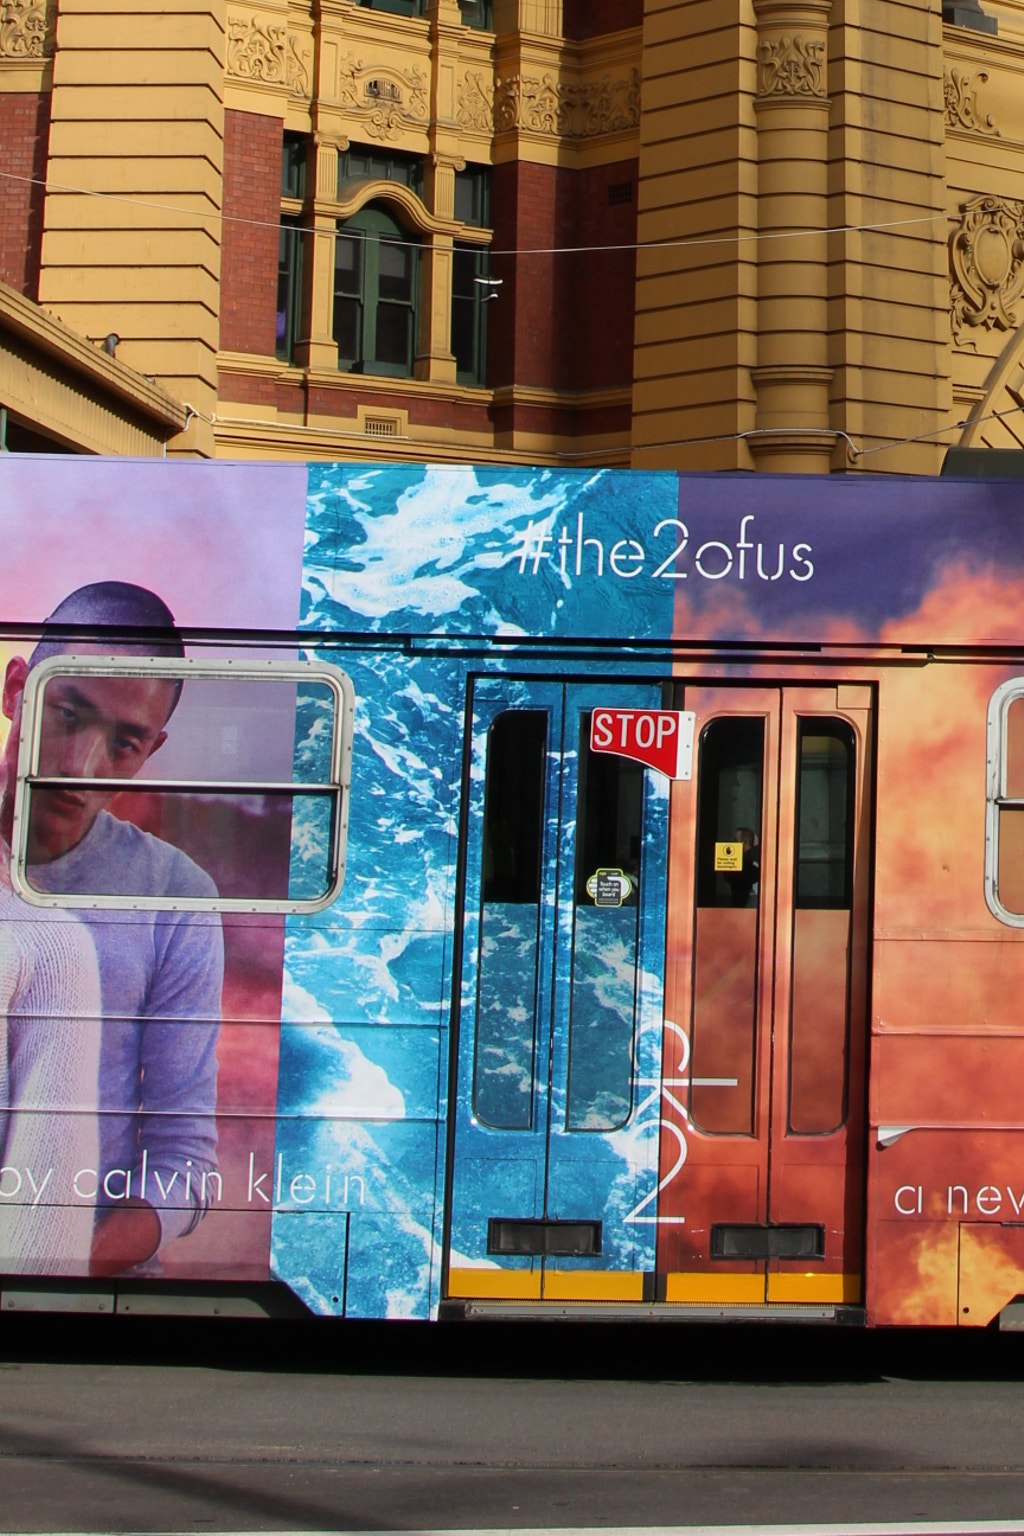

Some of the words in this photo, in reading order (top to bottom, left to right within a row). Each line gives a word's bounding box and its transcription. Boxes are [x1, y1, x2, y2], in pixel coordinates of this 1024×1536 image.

[518, 512, 815, 582] #the2ofus
[594, 713, 676, 749] STOP
[72, 1149, 223, 1201] calvin
[248, 1152, 366, 1205] klein
[894, 1184, 922, 1215] a
